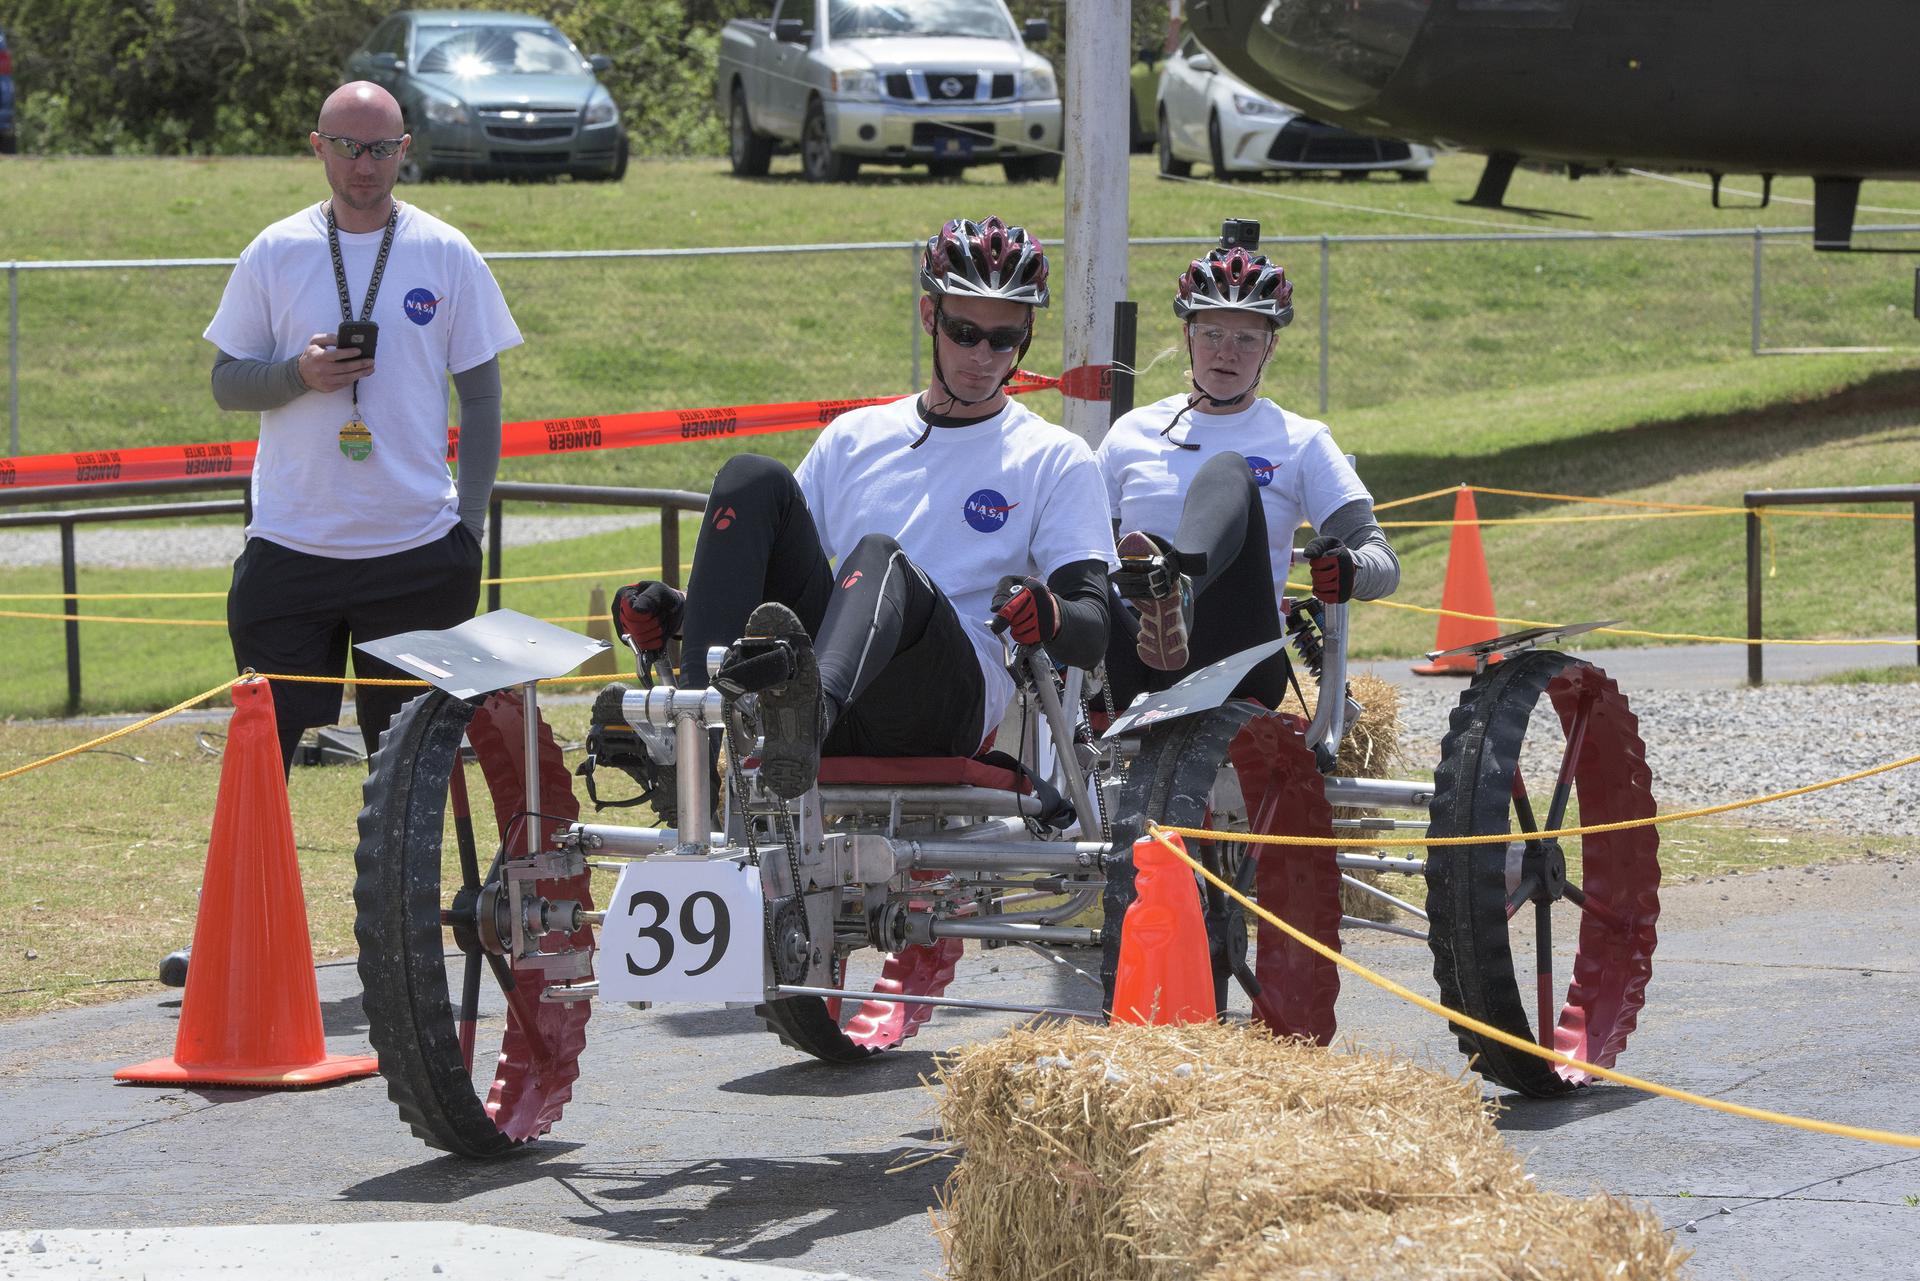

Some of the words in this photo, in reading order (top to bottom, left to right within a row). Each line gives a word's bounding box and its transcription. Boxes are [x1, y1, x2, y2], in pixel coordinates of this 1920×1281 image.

[407, 299, 434, 315] NASA
[677, 411, 704, 421] ENTER
[707, 408, 723, 418] NOT
[724, 407, 737, 417] DO
[544, 420, 569, 433] ENTER
[572, 419, 588, 430] NOT
[588, 418, 600, 429] DO
[681, 417, 737, 438] DANGER
[549, 429, 602, 450] DANGER
[184, 447, 206, 458] ENTER
[208, 446, 221, 457] NOT
[222, 445, 233, 456] DO
[74, 455, 96, 465] ENTER
[97, 453, 110, 463] NOT
[110, 452, 121, 462] DO
[185, 456, 233, 475] DANGER
[76, 464, 121, 482] DANGER
[968, 501, 1004, 522] NASA
[625, 890, 731, 976] 39
